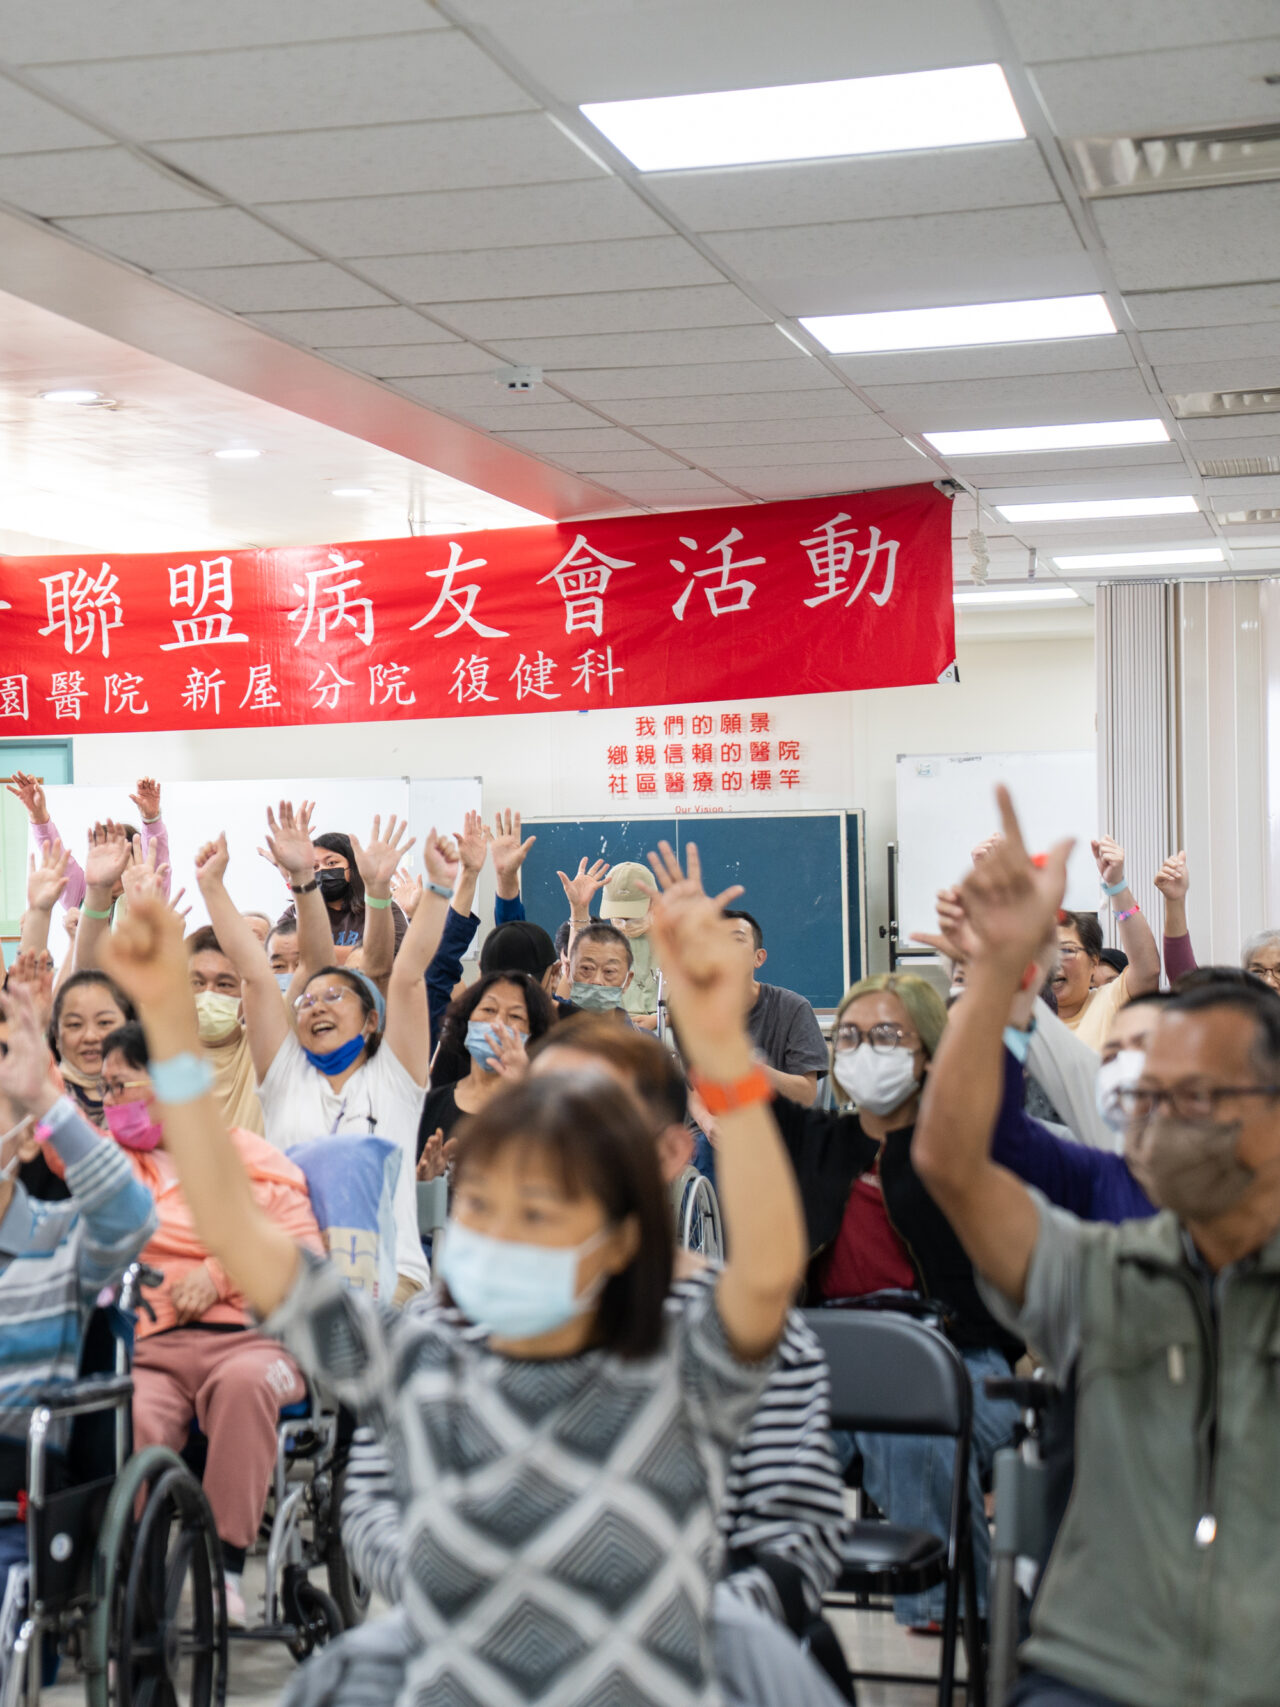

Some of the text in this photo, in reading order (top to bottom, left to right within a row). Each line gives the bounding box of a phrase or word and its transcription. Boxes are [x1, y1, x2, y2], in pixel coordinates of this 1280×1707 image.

[448, 645, 624, 704] 復健科
[635, 712, 770, 736] 我們的願景
[607, 740, 800, 765] 鄉親信賴的醫院
[608, 769, 801, 794] 社區醫療的標竿
[675, 805, 691, 814] Our
